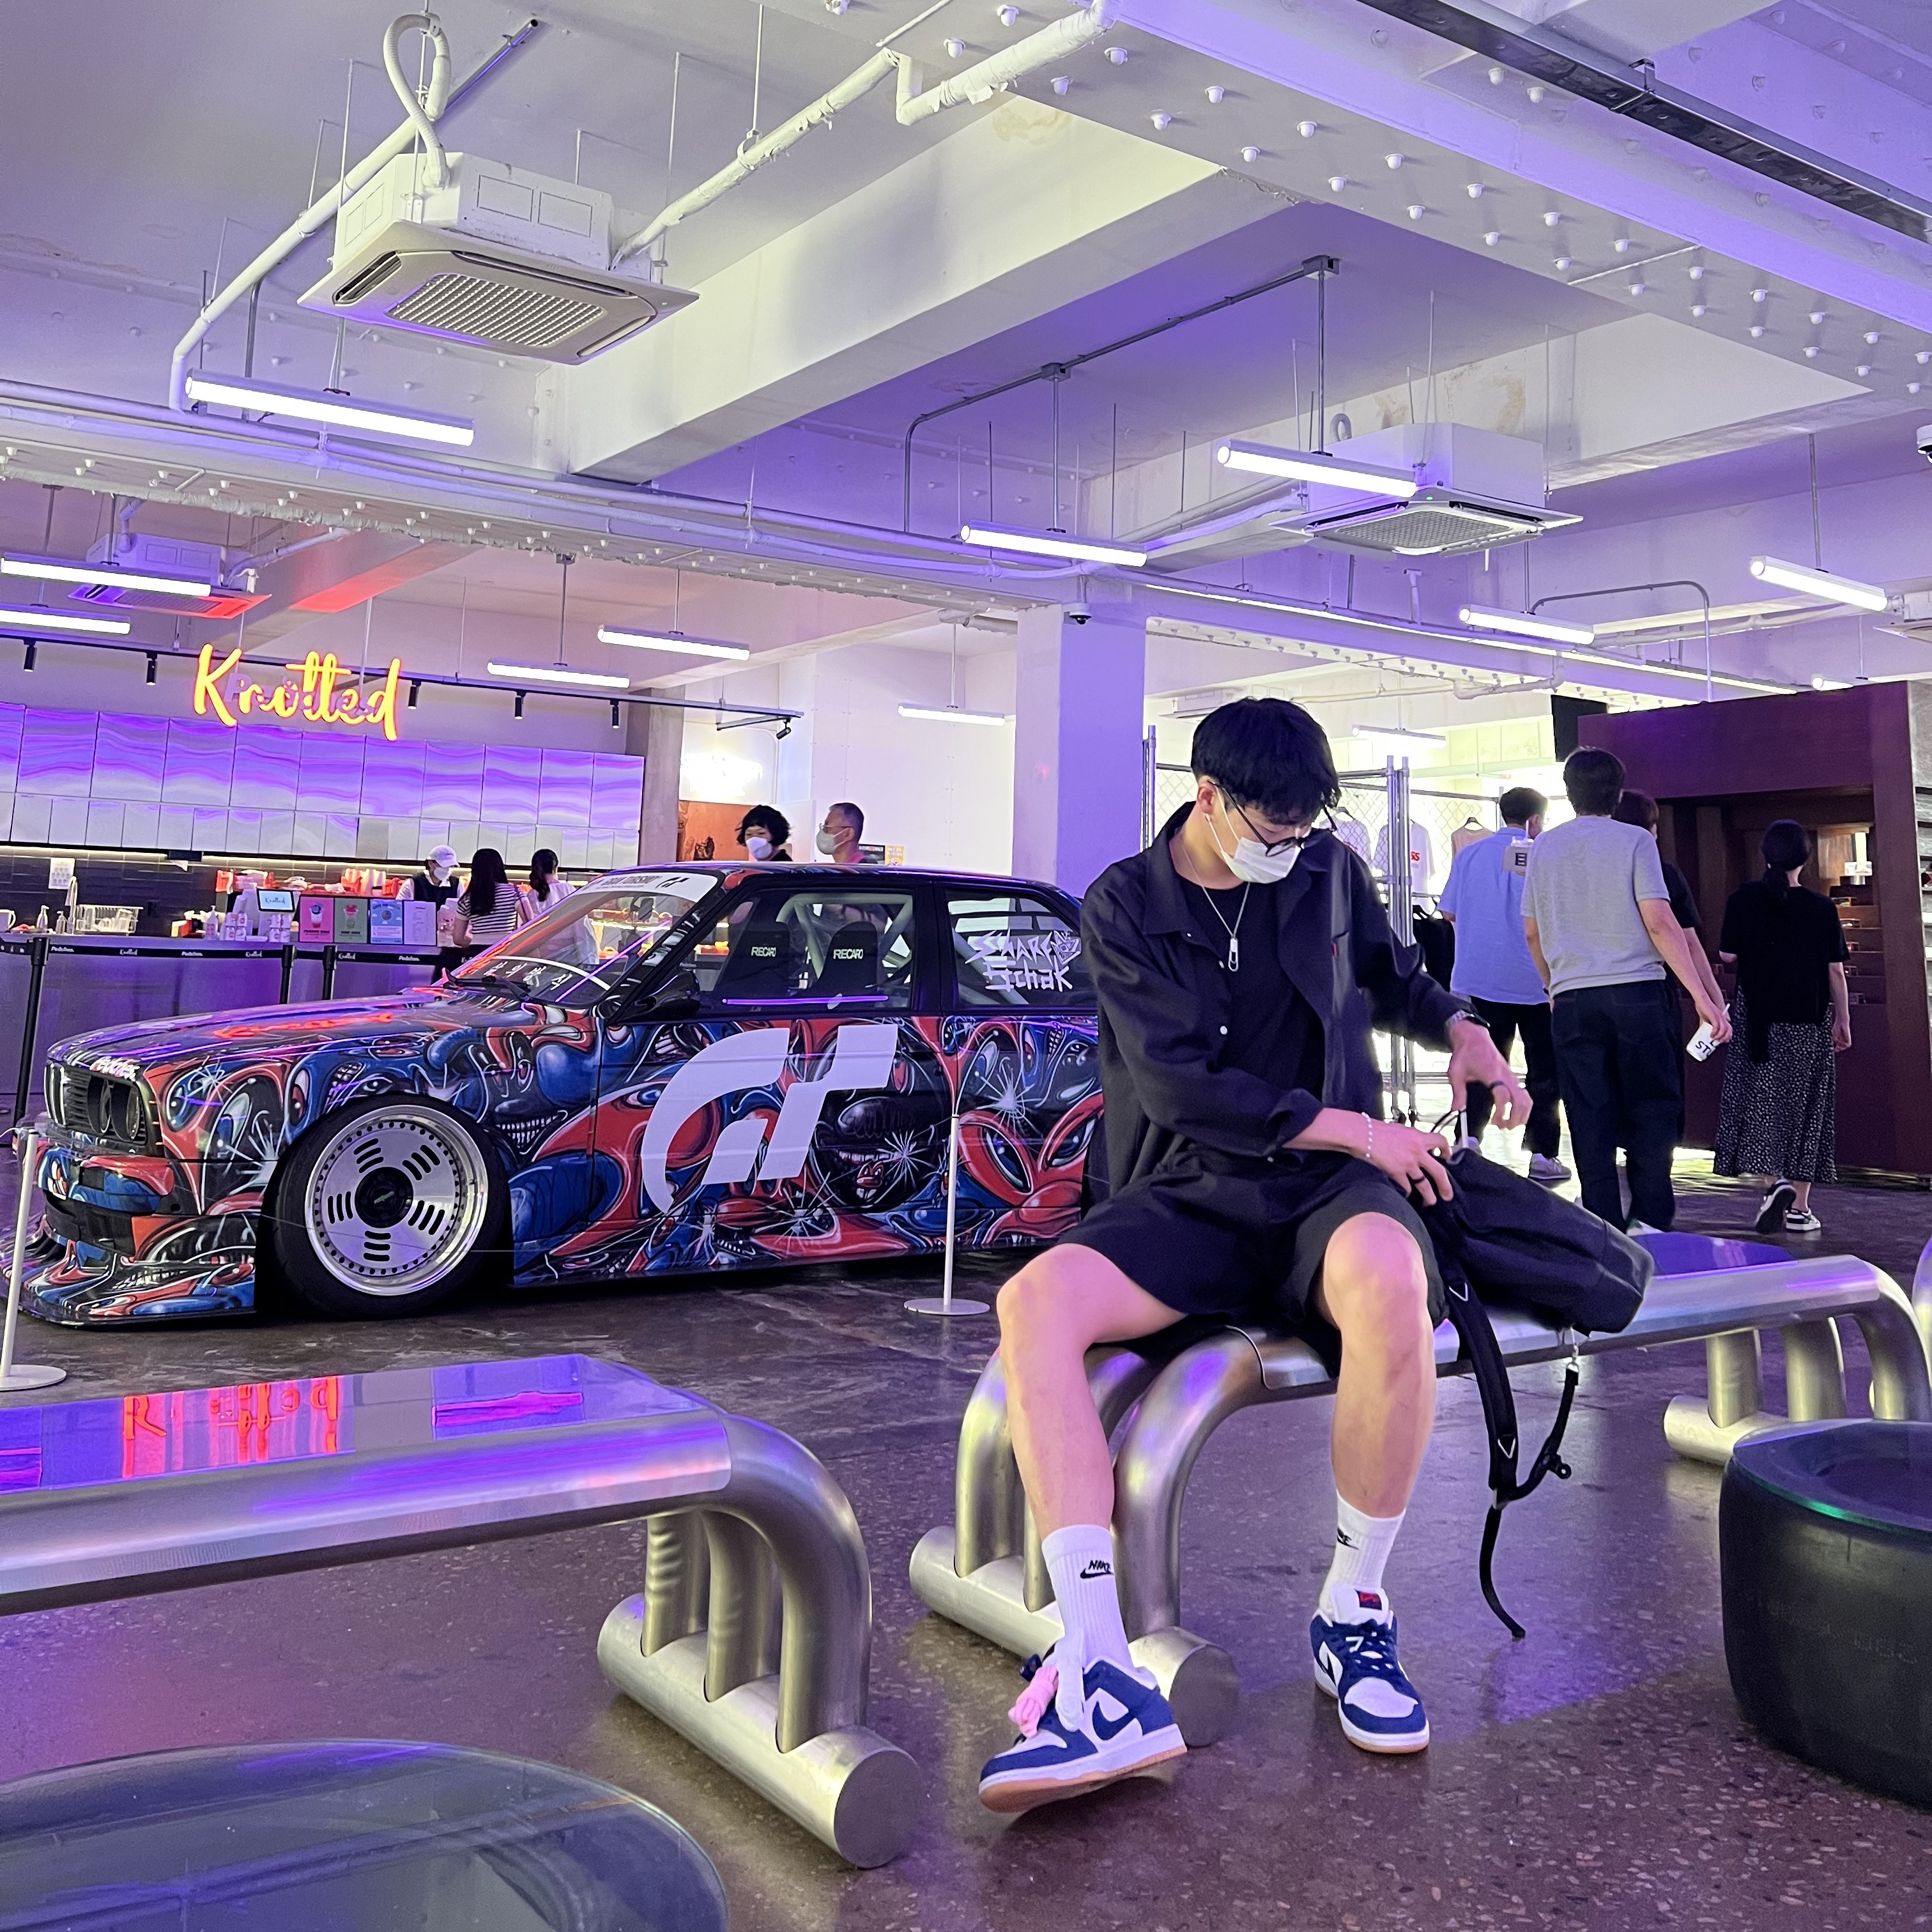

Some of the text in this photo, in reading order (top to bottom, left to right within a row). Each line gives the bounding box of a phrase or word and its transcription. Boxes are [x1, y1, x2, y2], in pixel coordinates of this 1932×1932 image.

[194, 643, 400, 741] Knotted
[751, 947, 776, 957] RECARO
[833, 949, 863, 959] RECARO
[1088, 1560, 1112, 1572] NIKE
